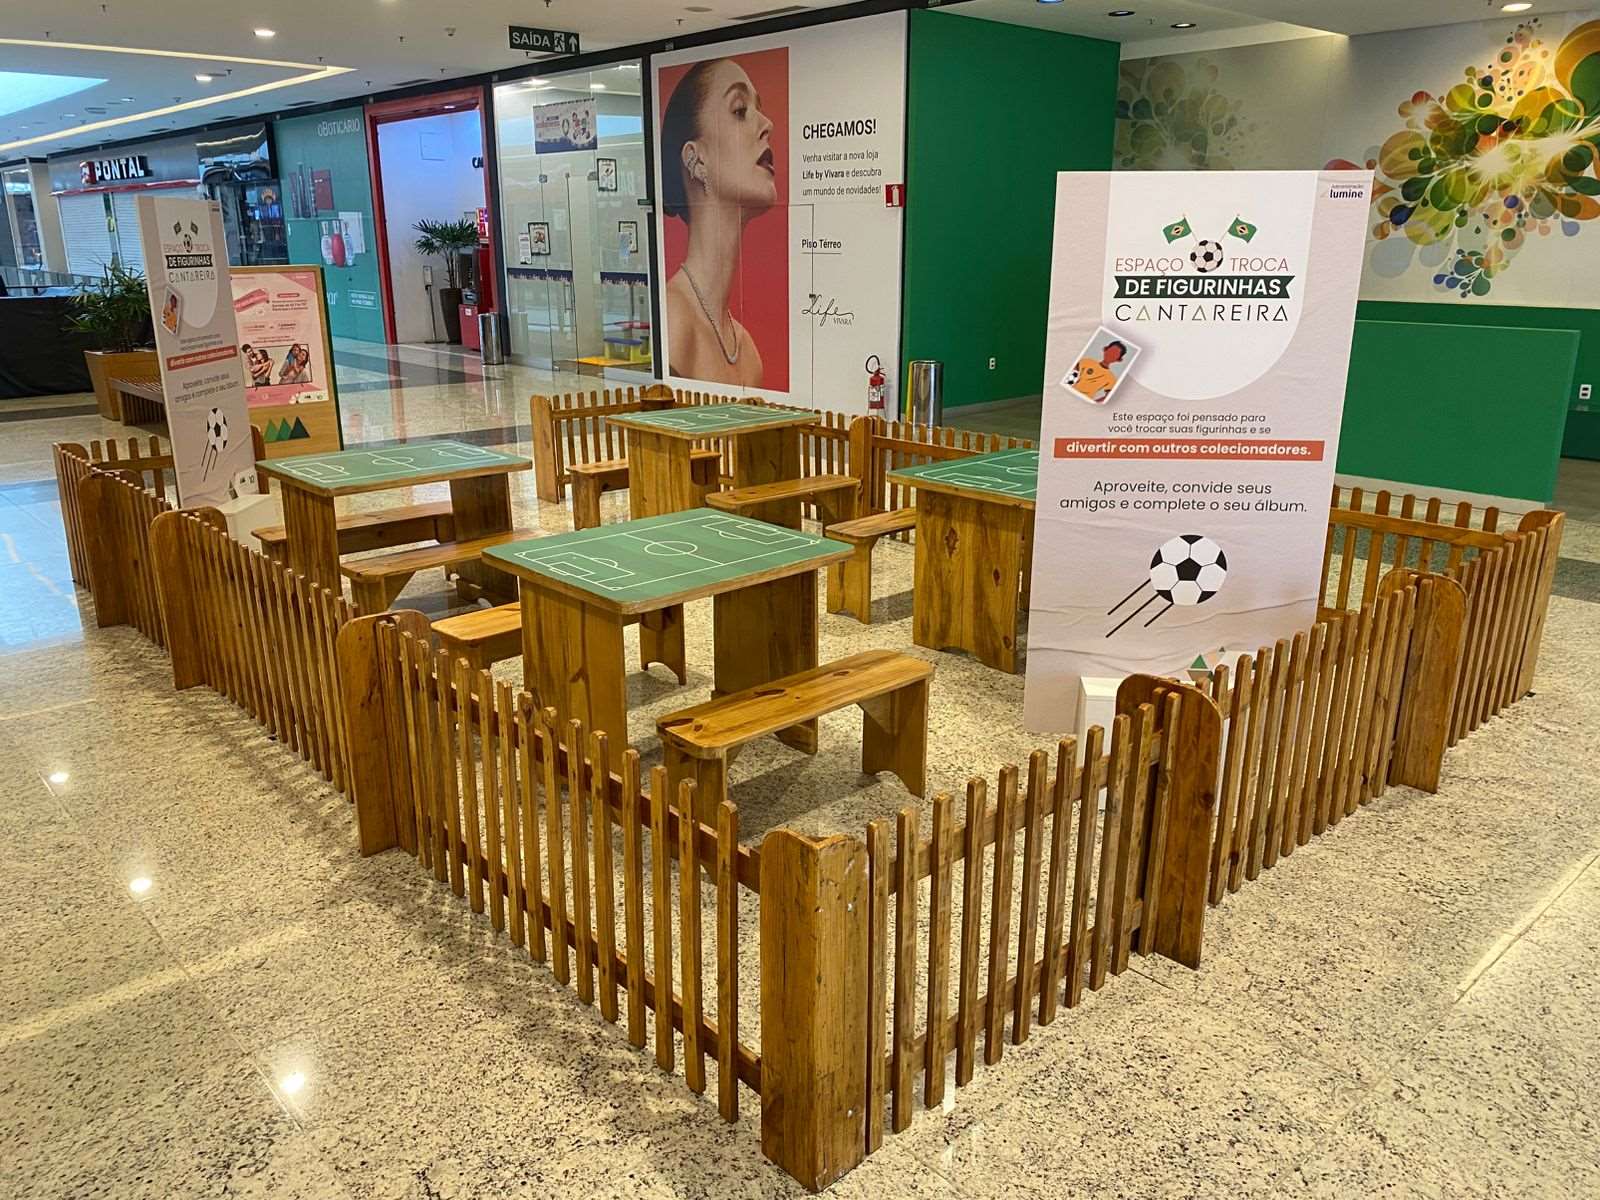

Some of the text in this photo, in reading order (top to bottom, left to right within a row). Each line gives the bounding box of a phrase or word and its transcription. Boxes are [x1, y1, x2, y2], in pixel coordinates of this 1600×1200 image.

[512, 31, 551, 47] SAÍDA
[802, 118, 877, 139] CHEGAMOS!
[802, 149, 879, 163] Venha visitar a nova loja
[94, 156, 145, 181] PONTAL
[802, 169, 814, 180] Life
[815, 169, 824, 181] by
[824, 169, 845, 179] Vivara
[851, 167, 882, 178] descubra
[802, 184, 882, 196] um mundo de novidades!
[1329, 189, 1364, 198] lumine
[801, 238, 842, 249] Piso Térreo
[1115, 257, 1289, 276] ESPAÇO TROCA
[1124, 278, 1281, 296] DE FIGURINHAS
[801, 294, 855, 327] Life
[1115, 304, 1289, 322] CANTAREIRA
[1112, 412, 1266, 425] Este espaço foi pensado para
[1108, 424, 1134, 433] você
[1135, 425, 1167, 433] trocar
[1195, 424, 1248, 436] figurinhas
[1066, 441, 1312, 456] divertir com outros colecionadores.
[1093, 480, 1272, 495] Aproveite, convide seus
[1059, 497, 1308, 512] amigos e complete o seu álbum.
